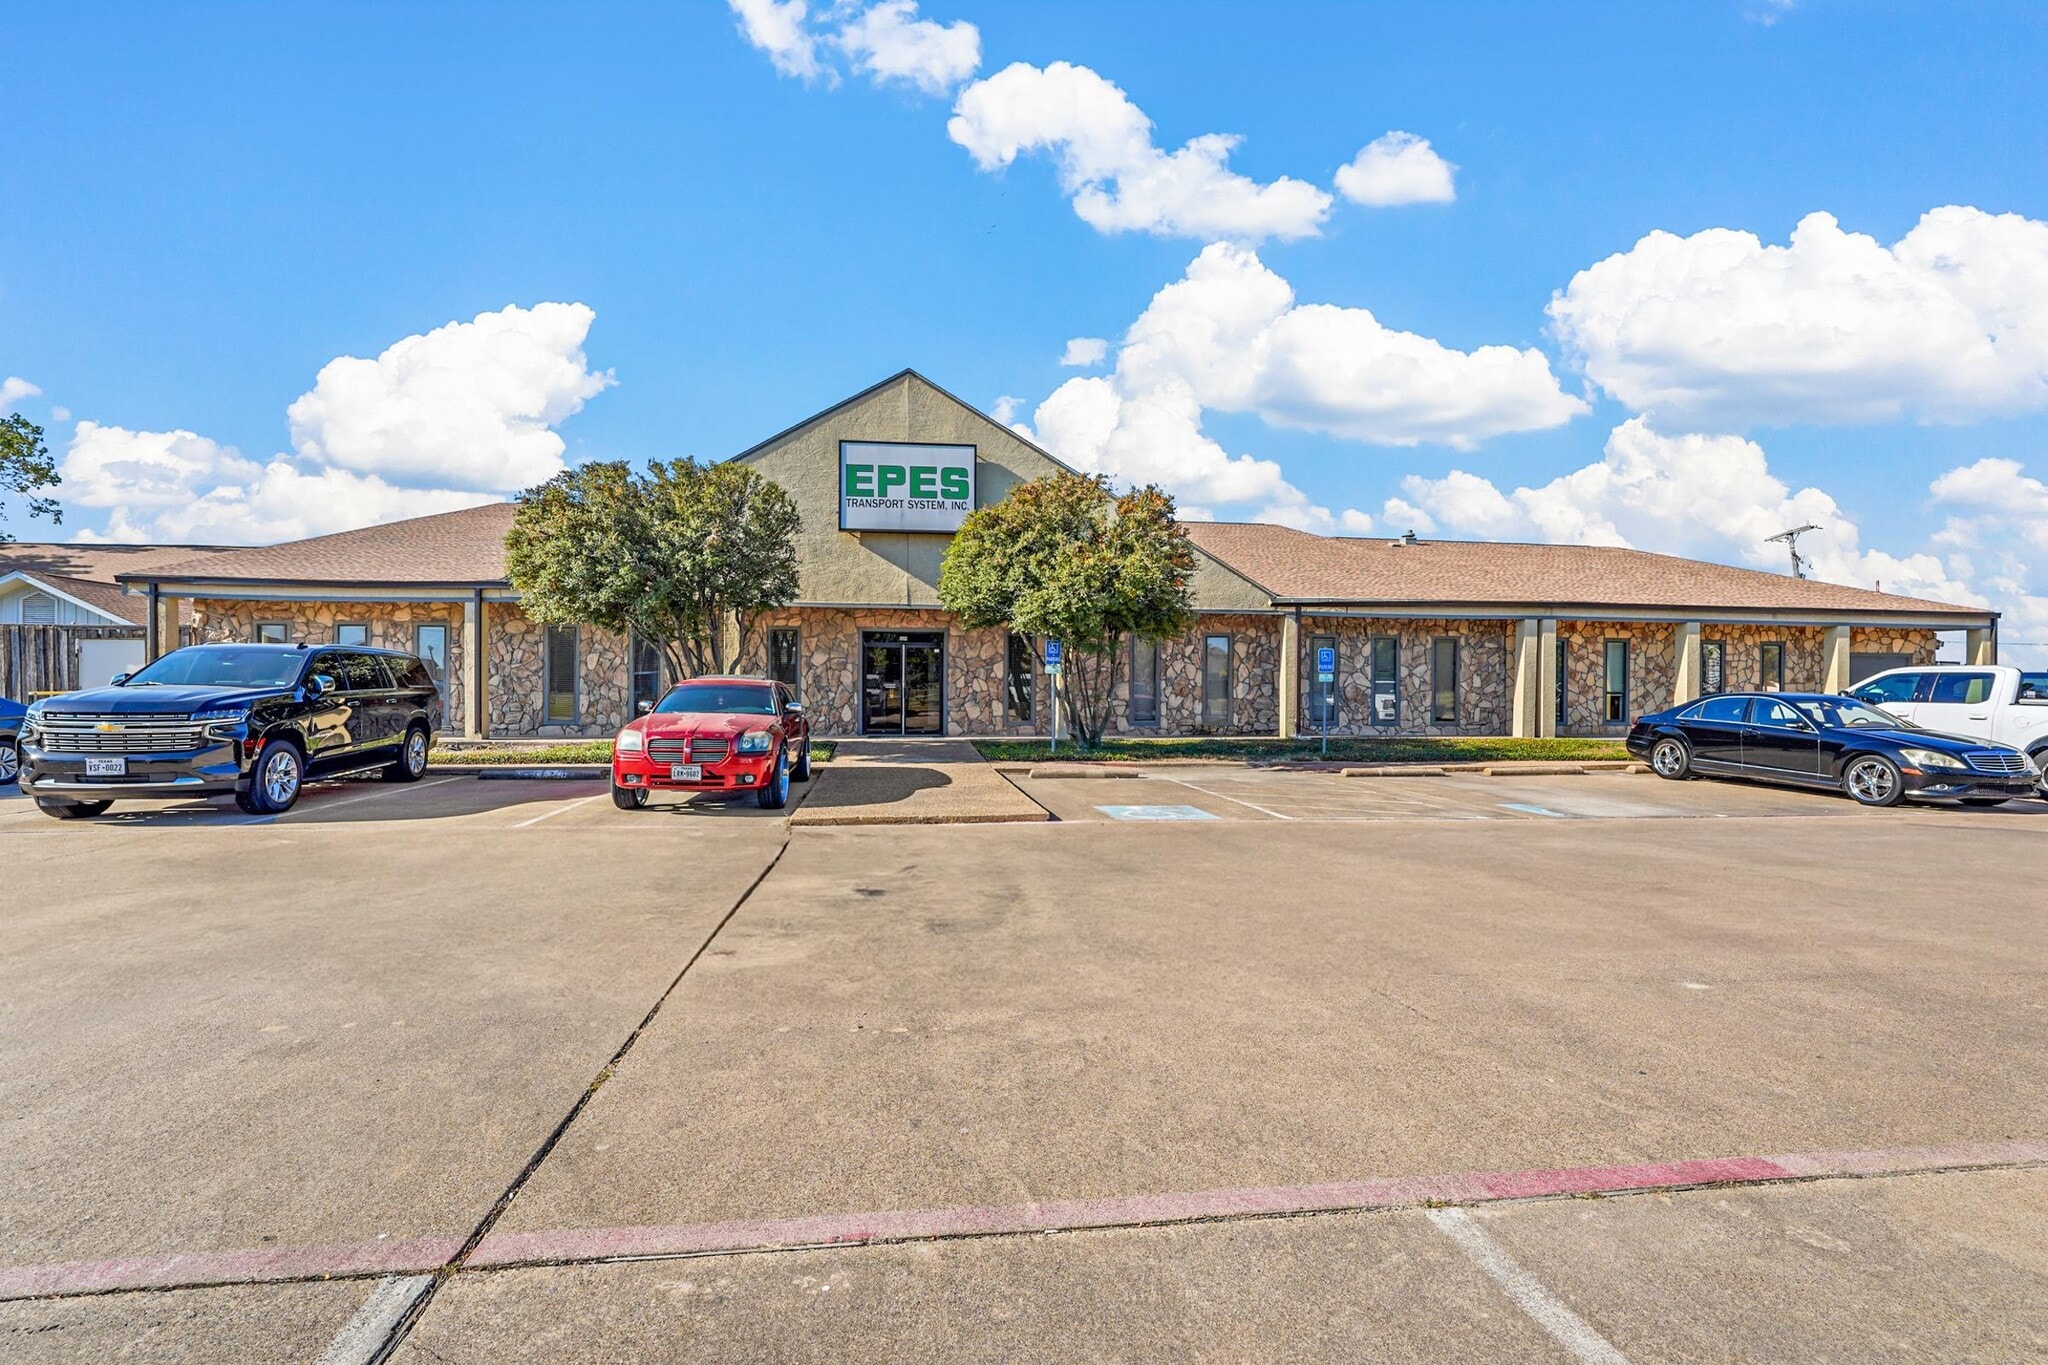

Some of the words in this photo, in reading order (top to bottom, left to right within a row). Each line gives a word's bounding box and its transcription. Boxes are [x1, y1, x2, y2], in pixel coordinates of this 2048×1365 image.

[846, 464, 969, 500] EPES
[846, 498, 904, 509] TRANSPORT
[907, 500, 948, 511] SYSTEM,
[951, 501, 970, 510] INC.
